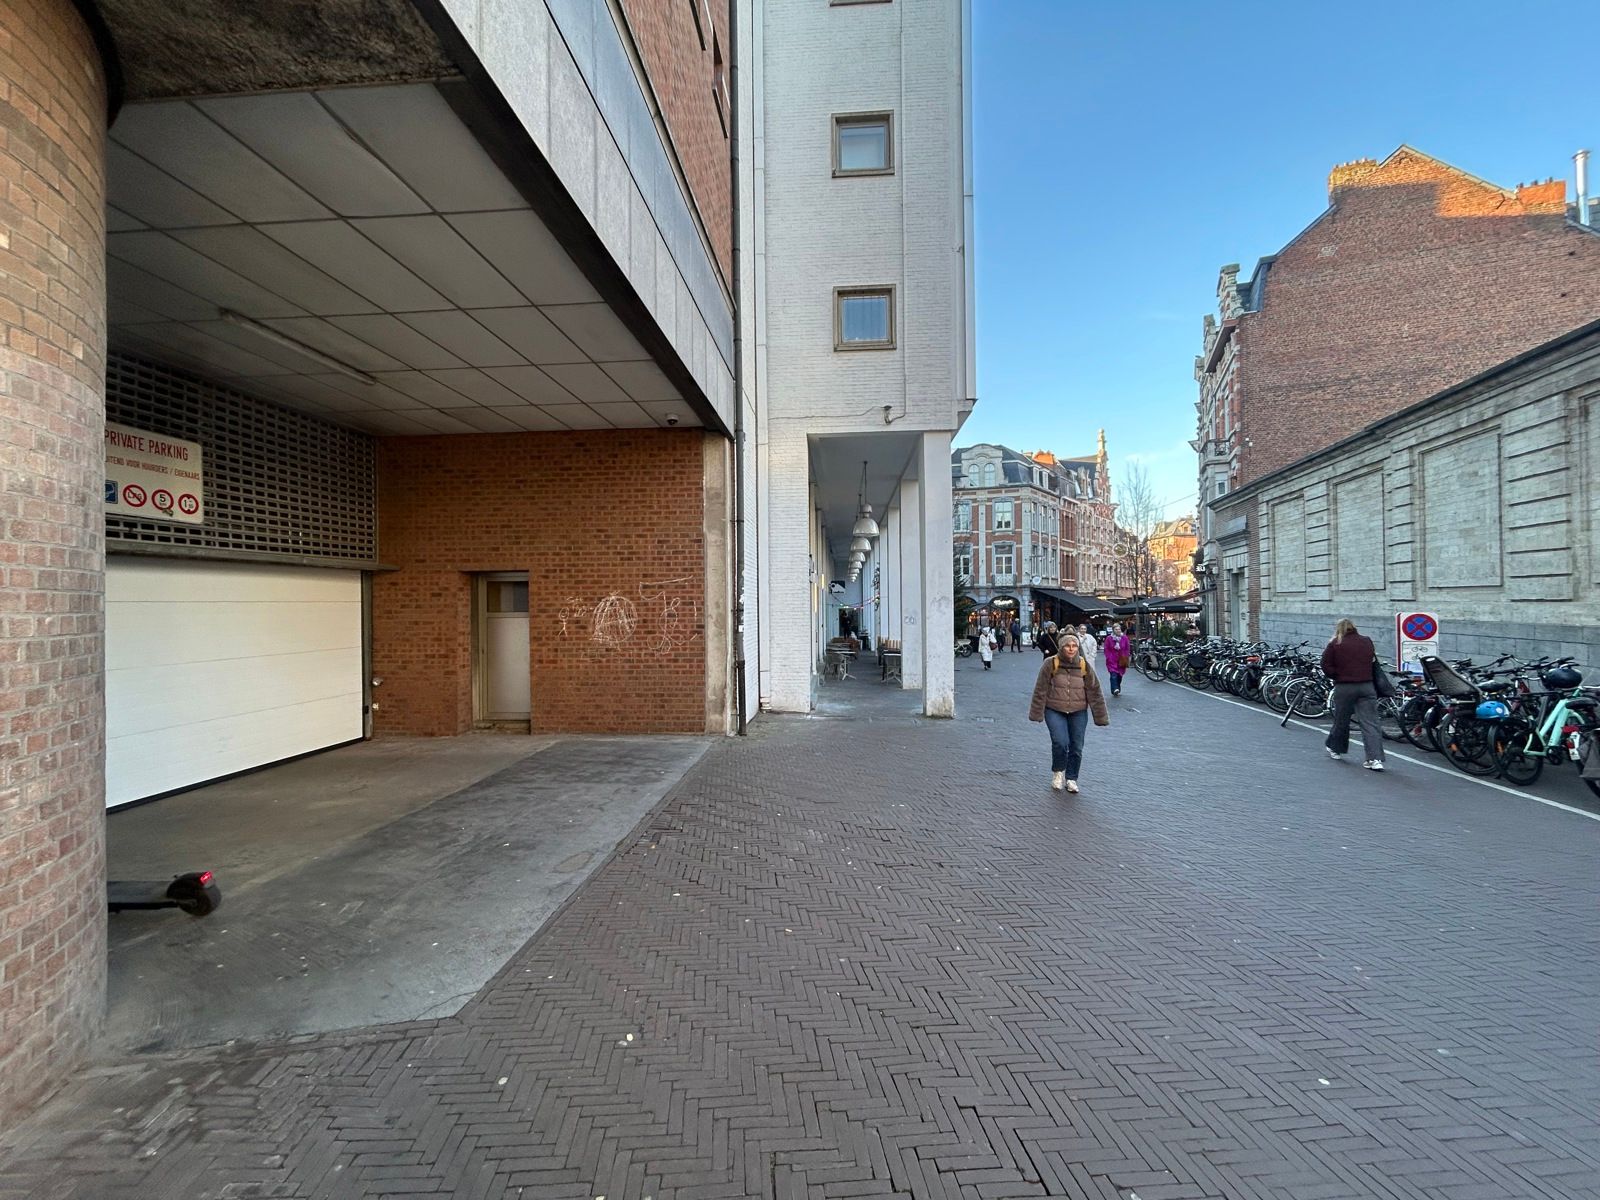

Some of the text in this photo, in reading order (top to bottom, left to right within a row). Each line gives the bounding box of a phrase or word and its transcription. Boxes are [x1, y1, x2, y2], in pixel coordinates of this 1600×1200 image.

[105, 429, 189, 461] PRIVATE PARKING
[159, 494, 166, 503] 5
